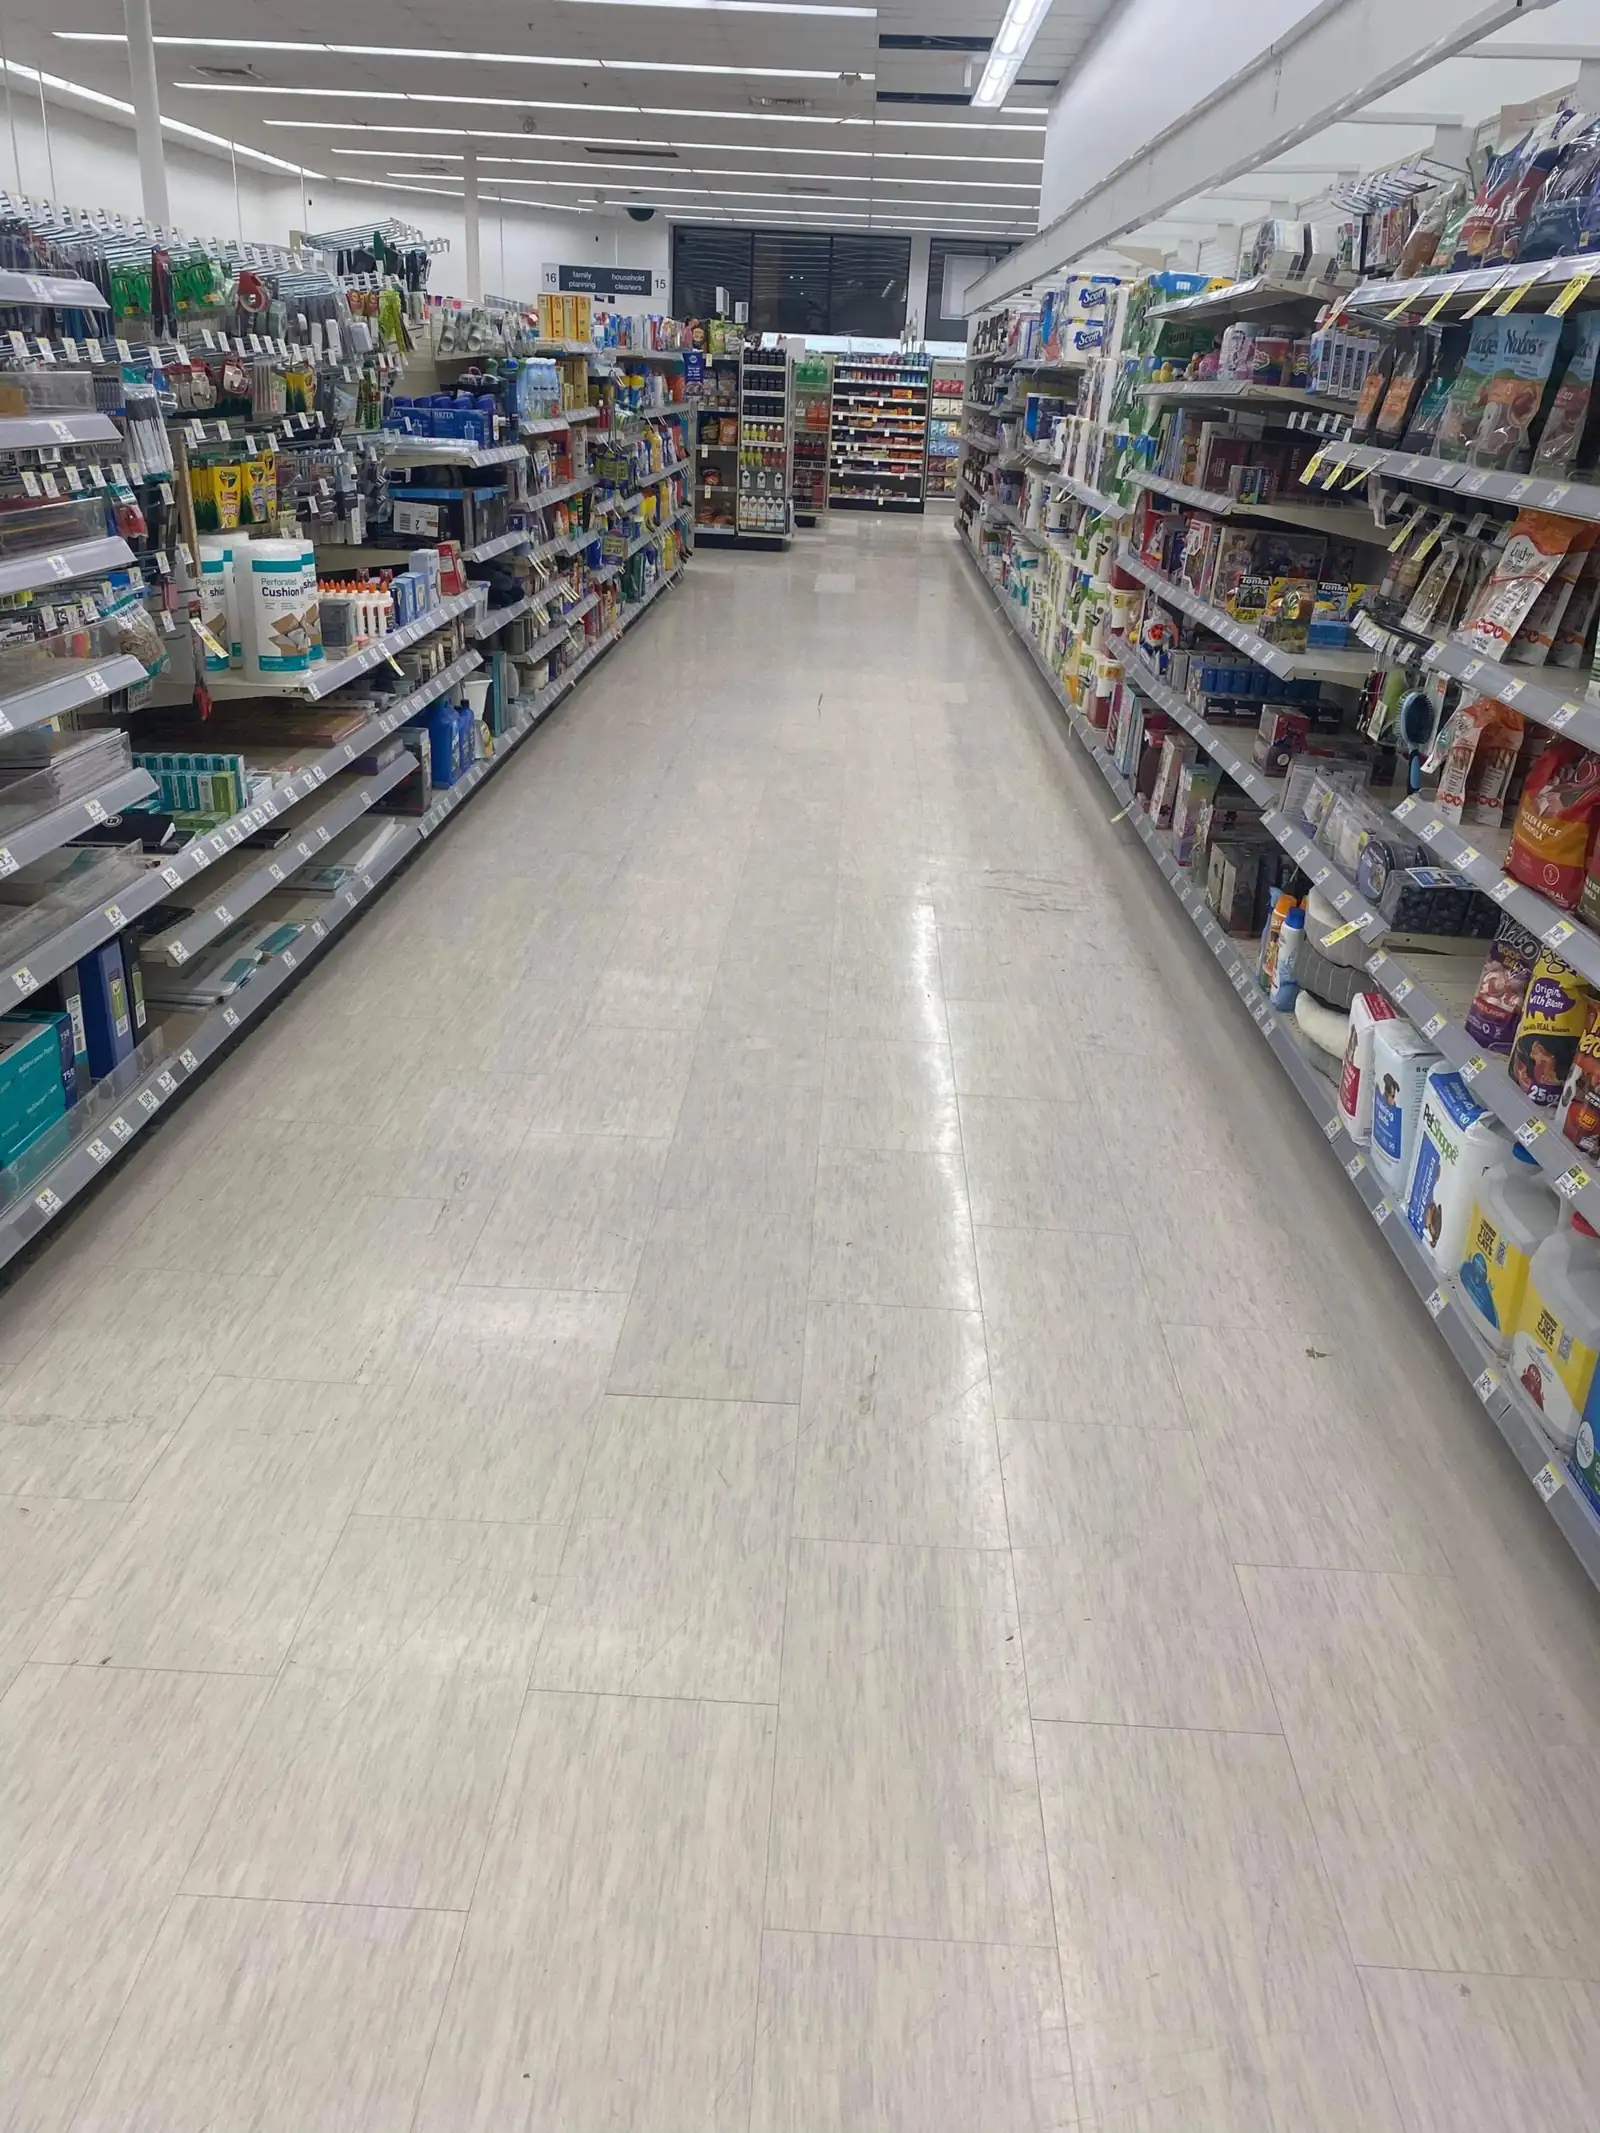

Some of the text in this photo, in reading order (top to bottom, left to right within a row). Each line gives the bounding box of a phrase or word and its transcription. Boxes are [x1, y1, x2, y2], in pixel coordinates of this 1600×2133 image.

[545, 272, 557, 283] 16
[572, 270, 592, 280] family
[611, 273, 645, 281] household
[568, 281, 596, 290] planning
[614, 282, 642, 291] cleaners
[654, 278, 666, 289] 15
[1083, 288, 1107, 303] Scott
[433, 411, 454, 419] BRITA
[1240, 575, 1269, 586] Tonka
[261, 586, 300, 597] Cushion
[1319, 581, 1349, 592] Tonka
[1541, 823, 1562, 837] RICE
[62, 1067, 75, 1081] 750
[1528, 1084, 1547, 1102] 25
[1480, 1223, 1495, 1244] TIDY
[1477, 1233, 1493, 1256] CATS
[1540, 1312, 1556, 1334] TIDY
[1537, 1322, 1554, 1346] CATS
